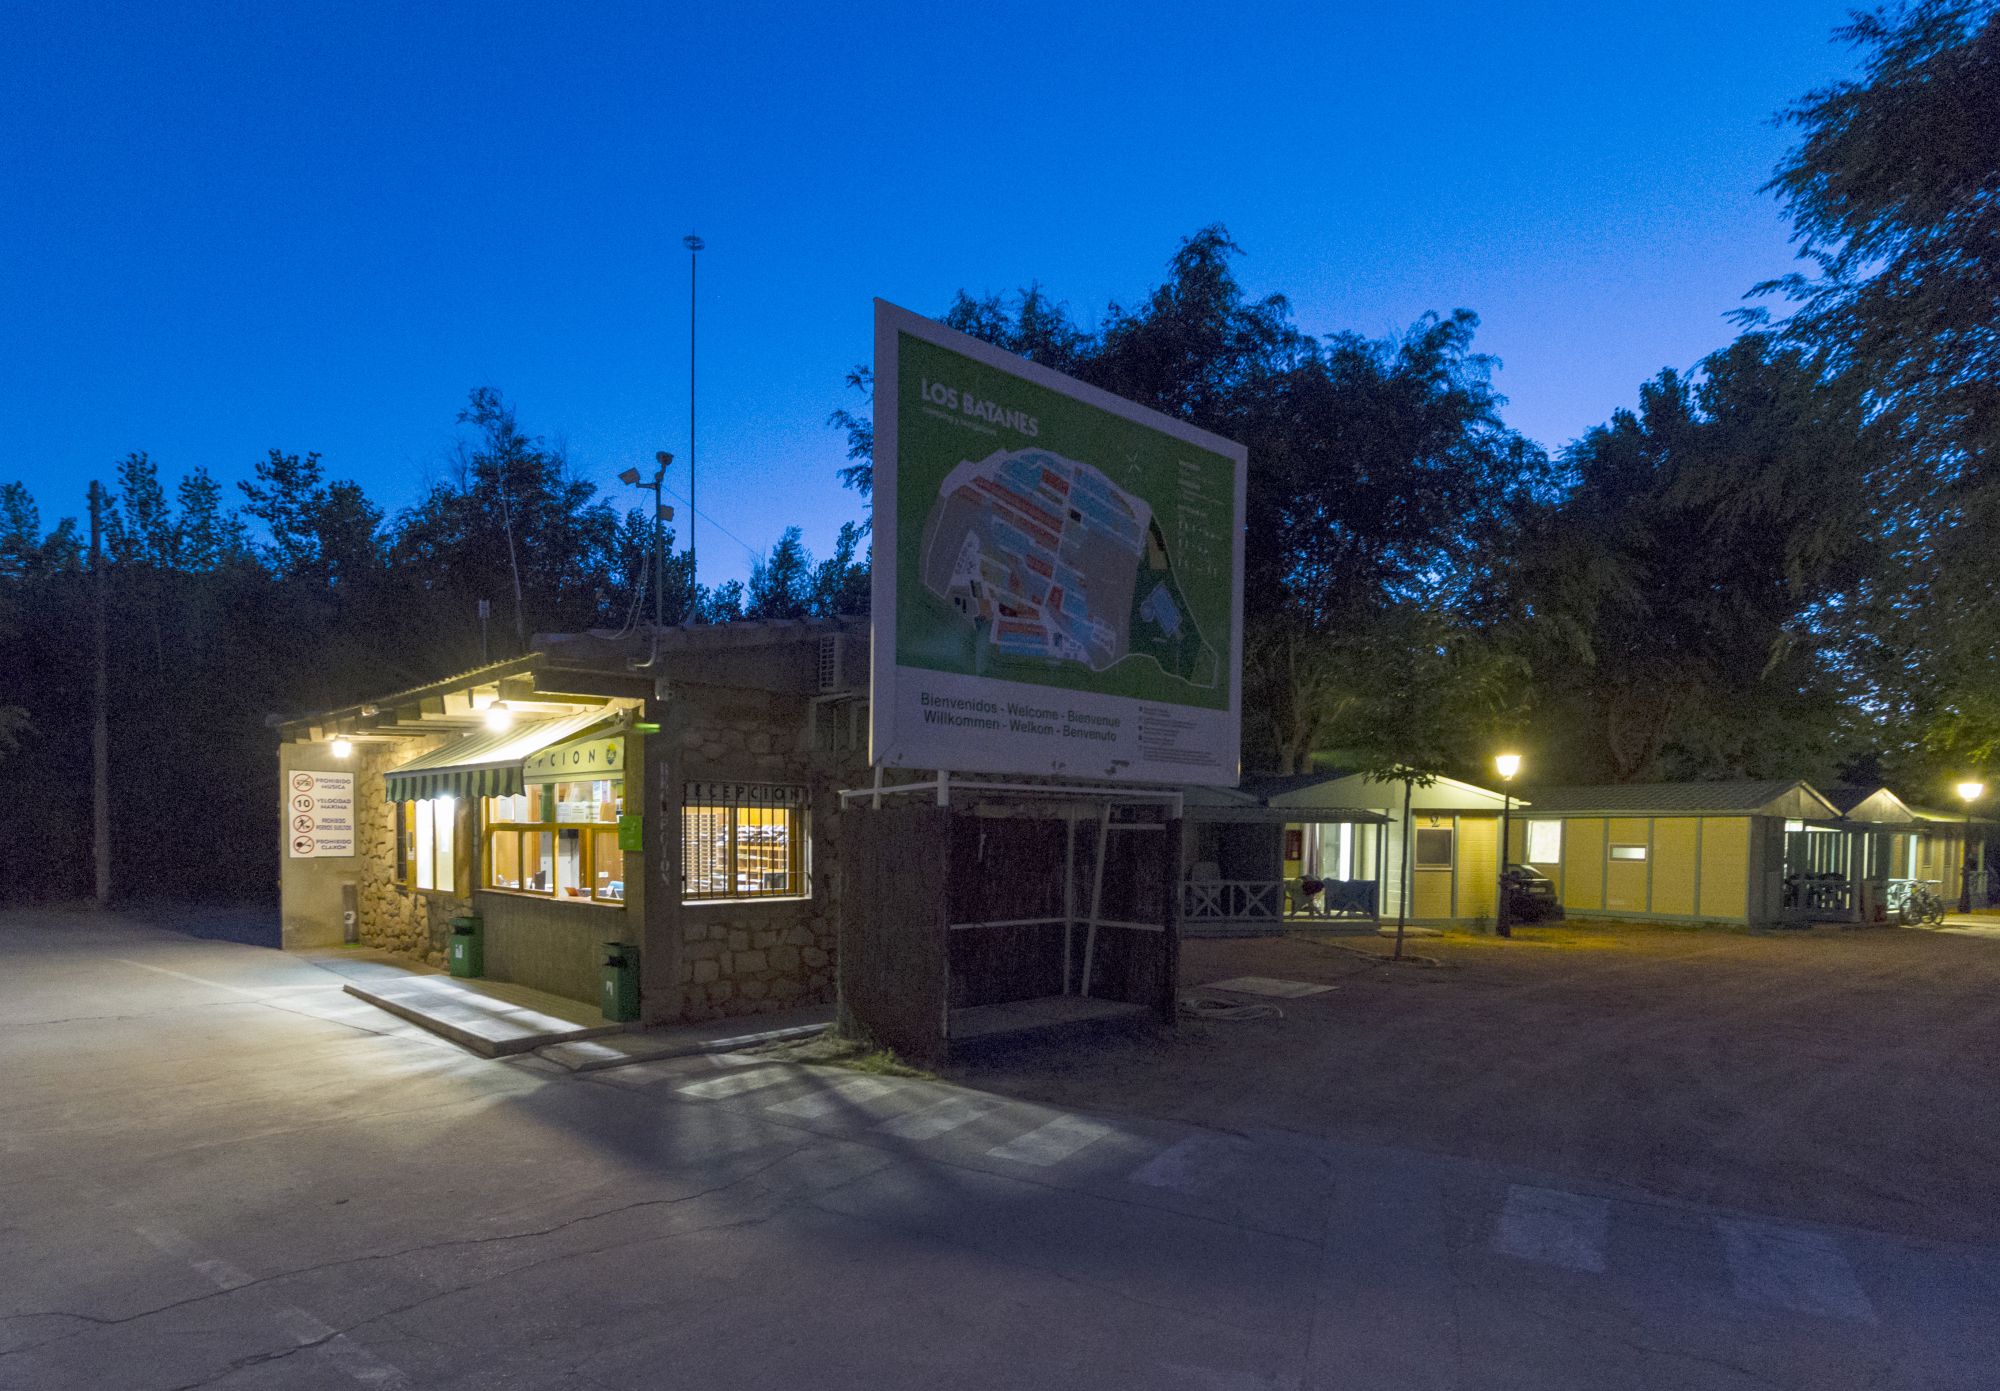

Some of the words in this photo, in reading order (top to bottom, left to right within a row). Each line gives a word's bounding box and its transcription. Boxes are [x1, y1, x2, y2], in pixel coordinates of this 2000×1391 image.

[921, 377, 958, 410] LOS
[963, 392, 1039, 437] BATANES
[920, 692, 998, 714] Bienvenidos
[1007, 702, 1059, 720] Welcome
[1067, 710, 1121, 728] Bienvenue
[923, 709, 1000, 731] Willkommen
[1009, 719, 1054, 736] Welkom
[1062, 725, 1117, 742] Benvenuto
[297, 799, 310, 808] 10
